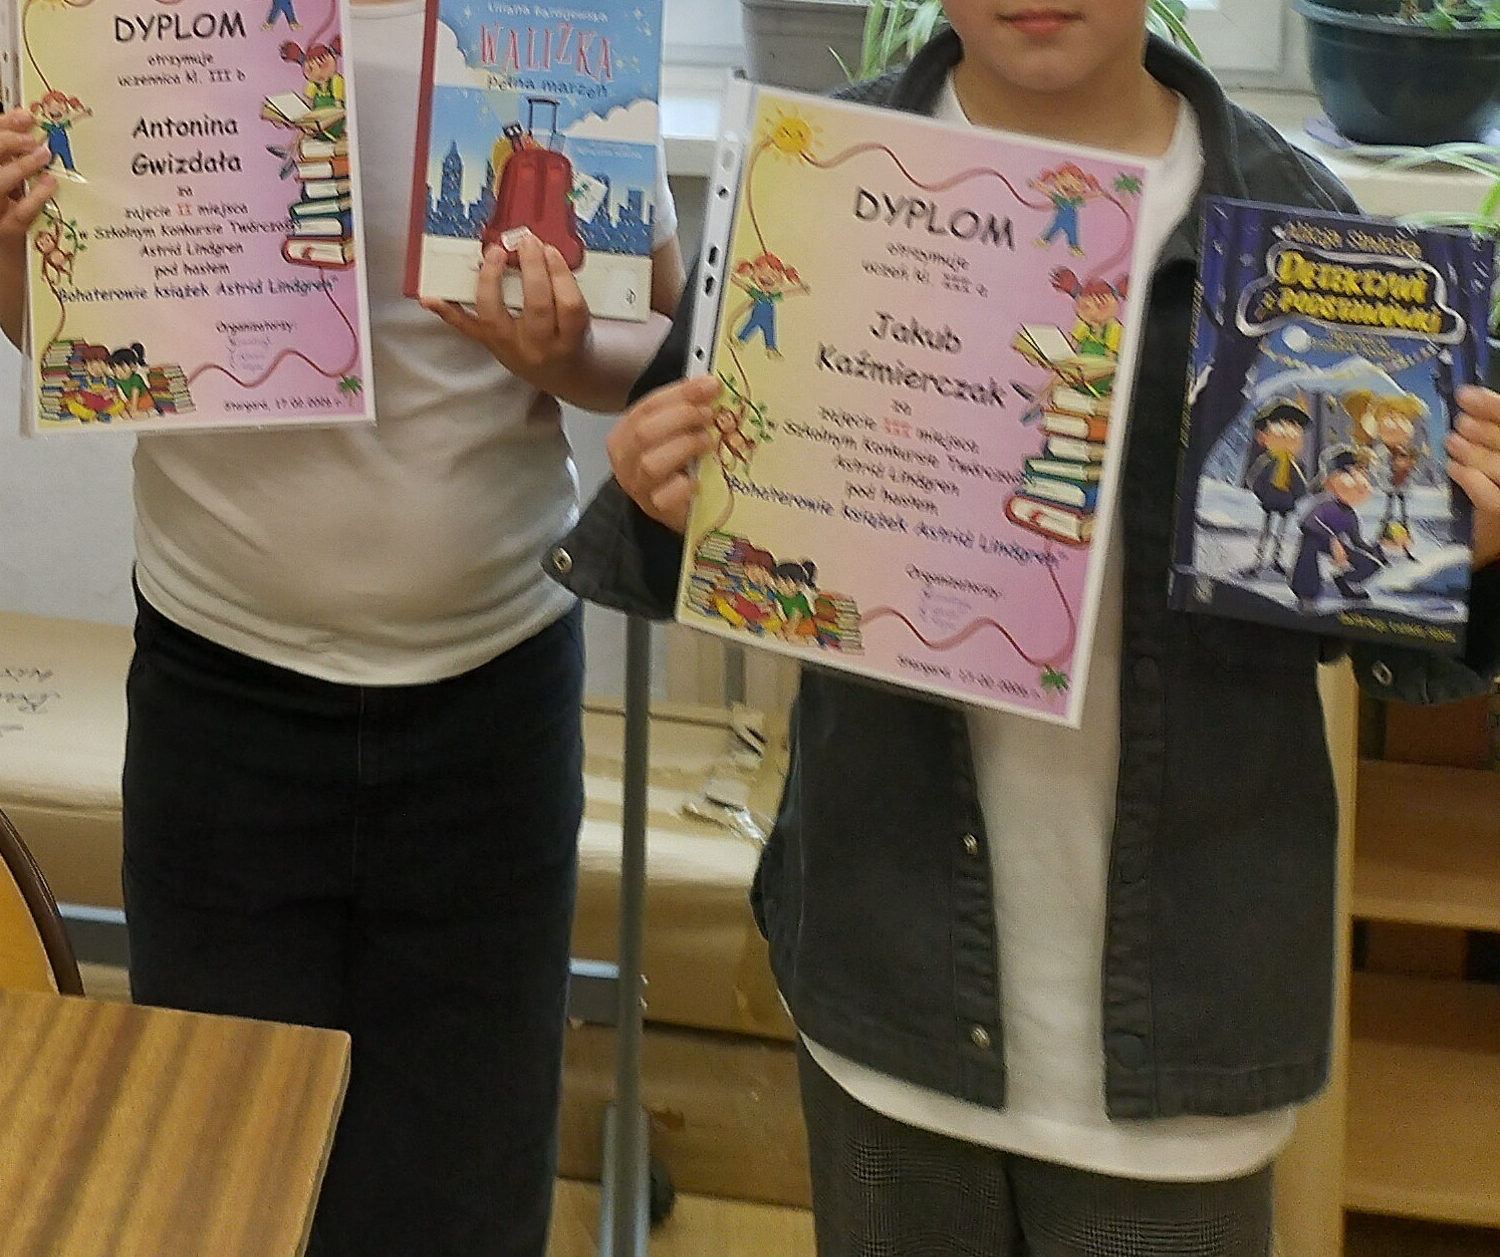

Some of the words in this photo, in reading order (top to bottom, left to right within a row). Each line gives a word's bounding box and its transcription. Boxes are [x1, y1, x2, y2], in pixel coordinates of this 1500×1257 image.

[114, 10, 247, 43] DYPLOM
[148, 50, 215, 68] otrzymuje
[479, 21, 614, 83] WALIZKA
[132, 113, 239, 139] Antonina
[131, 147, 243, 177] Gwizdała
[853, 186, 1016, 252] DYPLOM
[868, 309, 963, 355] Jakub
